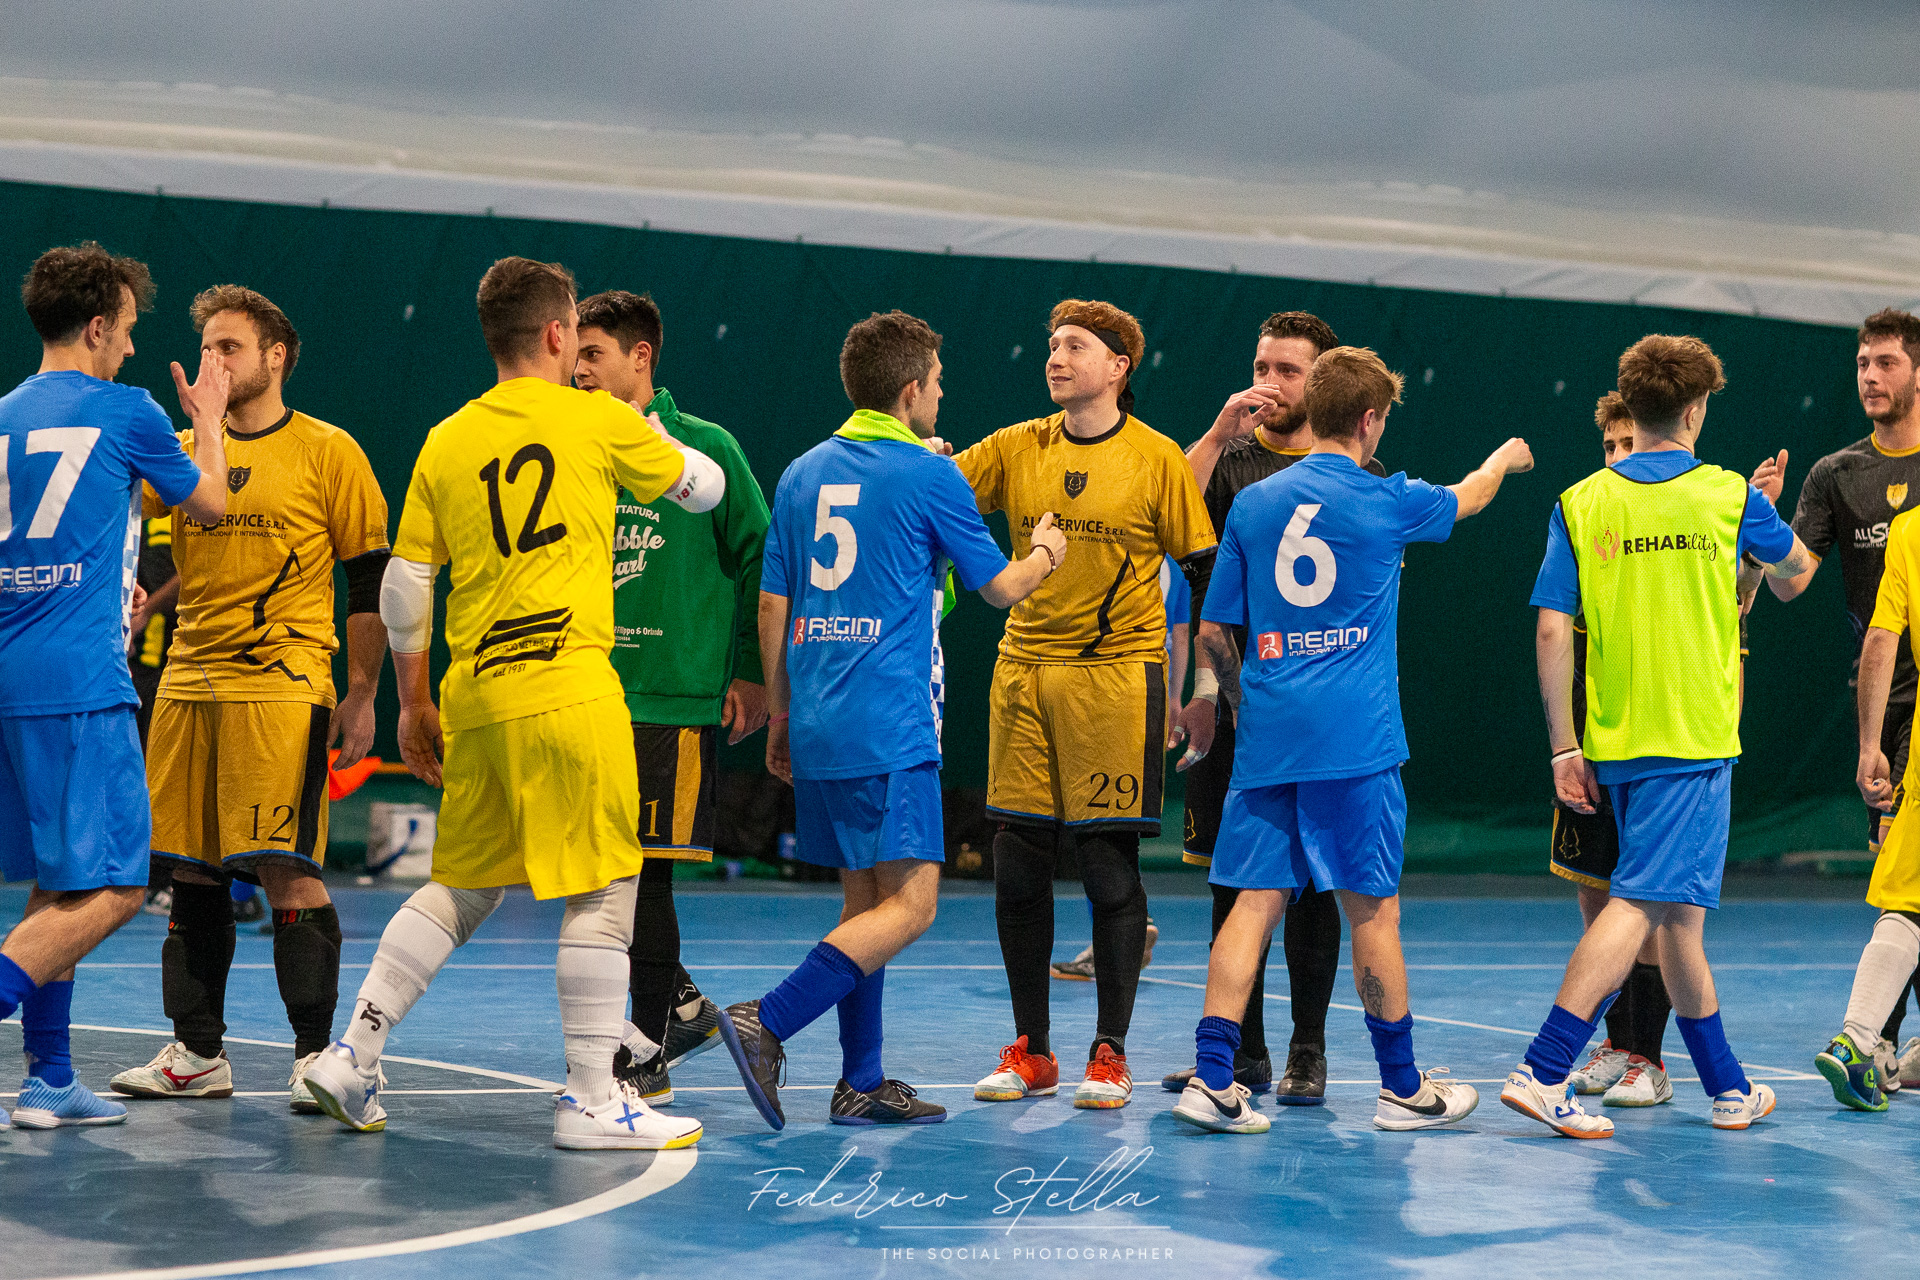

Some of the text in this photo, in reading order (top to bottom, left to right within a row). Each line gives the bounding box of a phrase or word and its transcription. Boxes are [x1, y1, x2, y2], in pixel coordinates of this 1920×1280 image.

[479, 443, 567, 558] 12
[266, 520, 288, 530] S.R.L.
[810, 484, 861, 591] 5
[1105, 527, 1127, 536] S.R.L.
[1275, 503, 1337, 608] 6
[1623, 533, 1719, 561] REHABility
[0, 563, 82, 586] REGINI
[612, 550, 647, 577] arl
[1287, 627, 1368, 650] REGINI
[508, 663, 527, 674] 1981
[1087, 772, 1138, 810] 29
[249, 803, 294, 844] 12
[645, 799, 660, 837] 1
